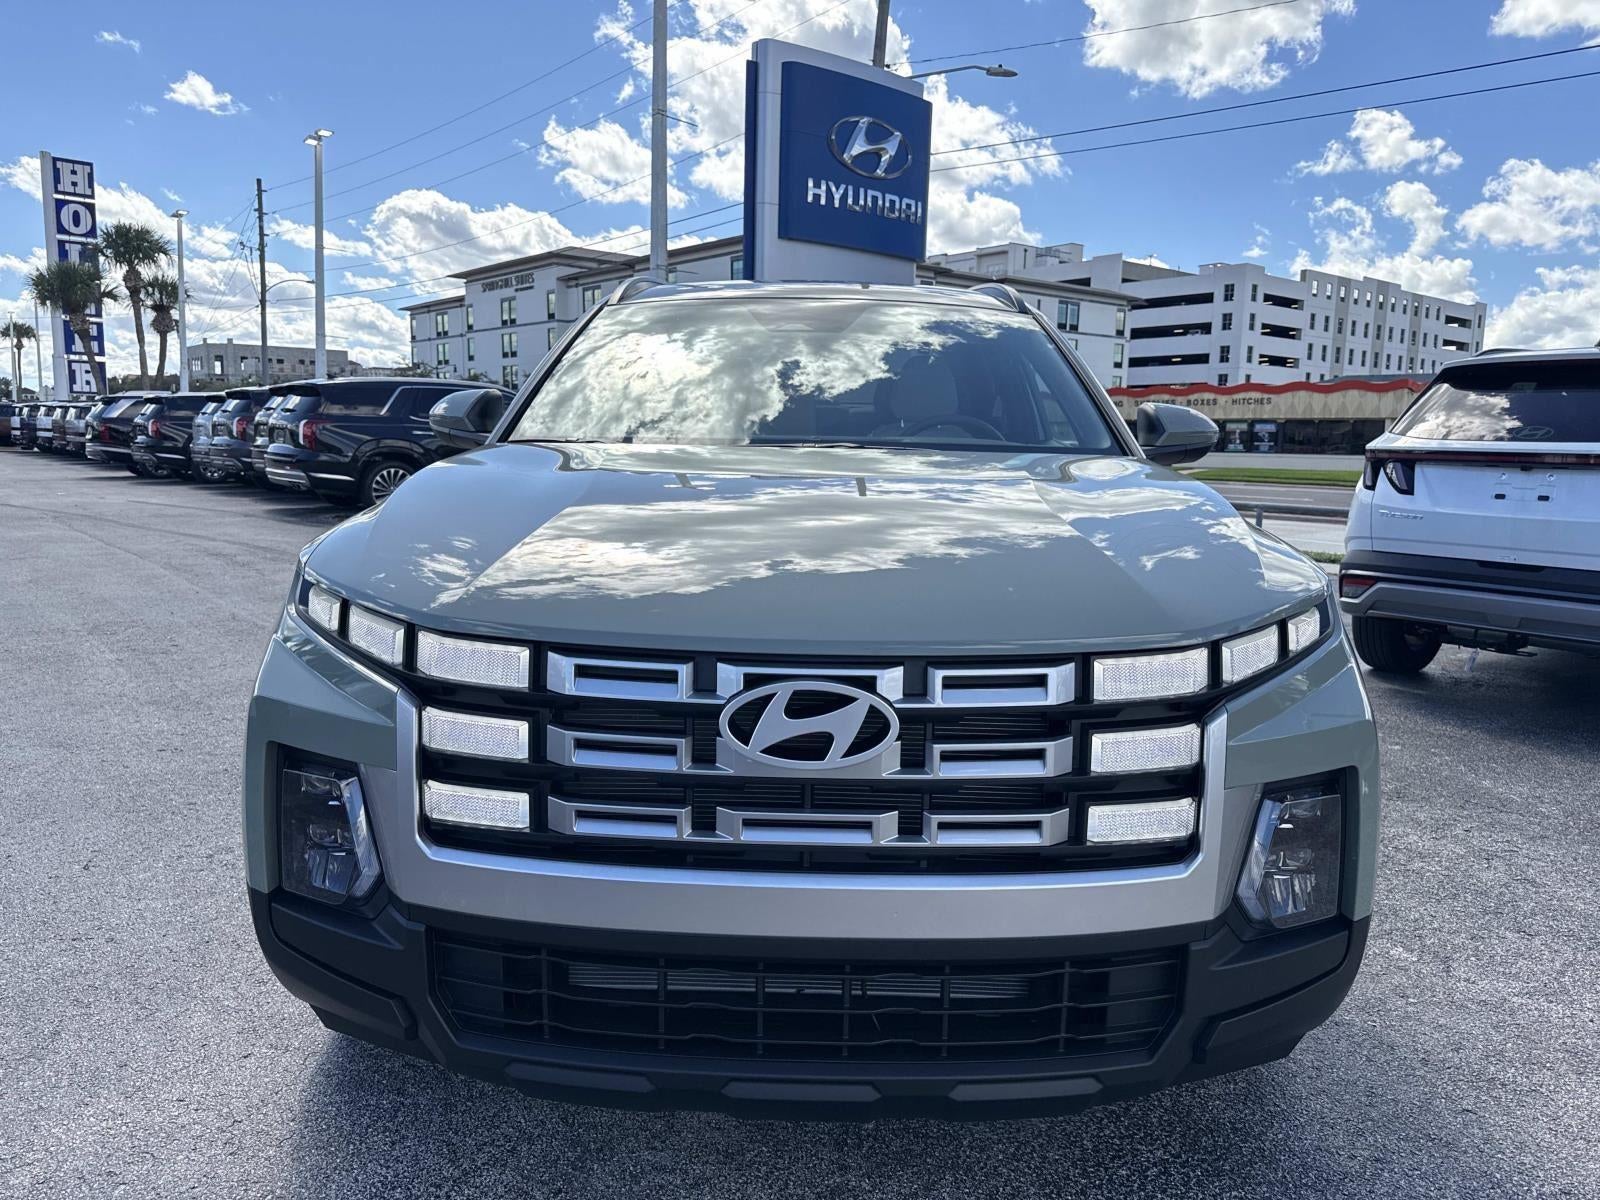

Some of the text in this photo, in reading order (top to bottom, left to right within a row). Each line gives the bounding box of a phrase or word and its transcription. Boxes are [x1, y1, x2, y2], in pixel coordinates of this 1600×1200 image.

[807, 177, 922, 225] HYUNDAI
[56, 160, 100, 393] HOER
[1186, 398, 1218, 407] BOXES
[1231, 397, 1272, 406] HITCHES
